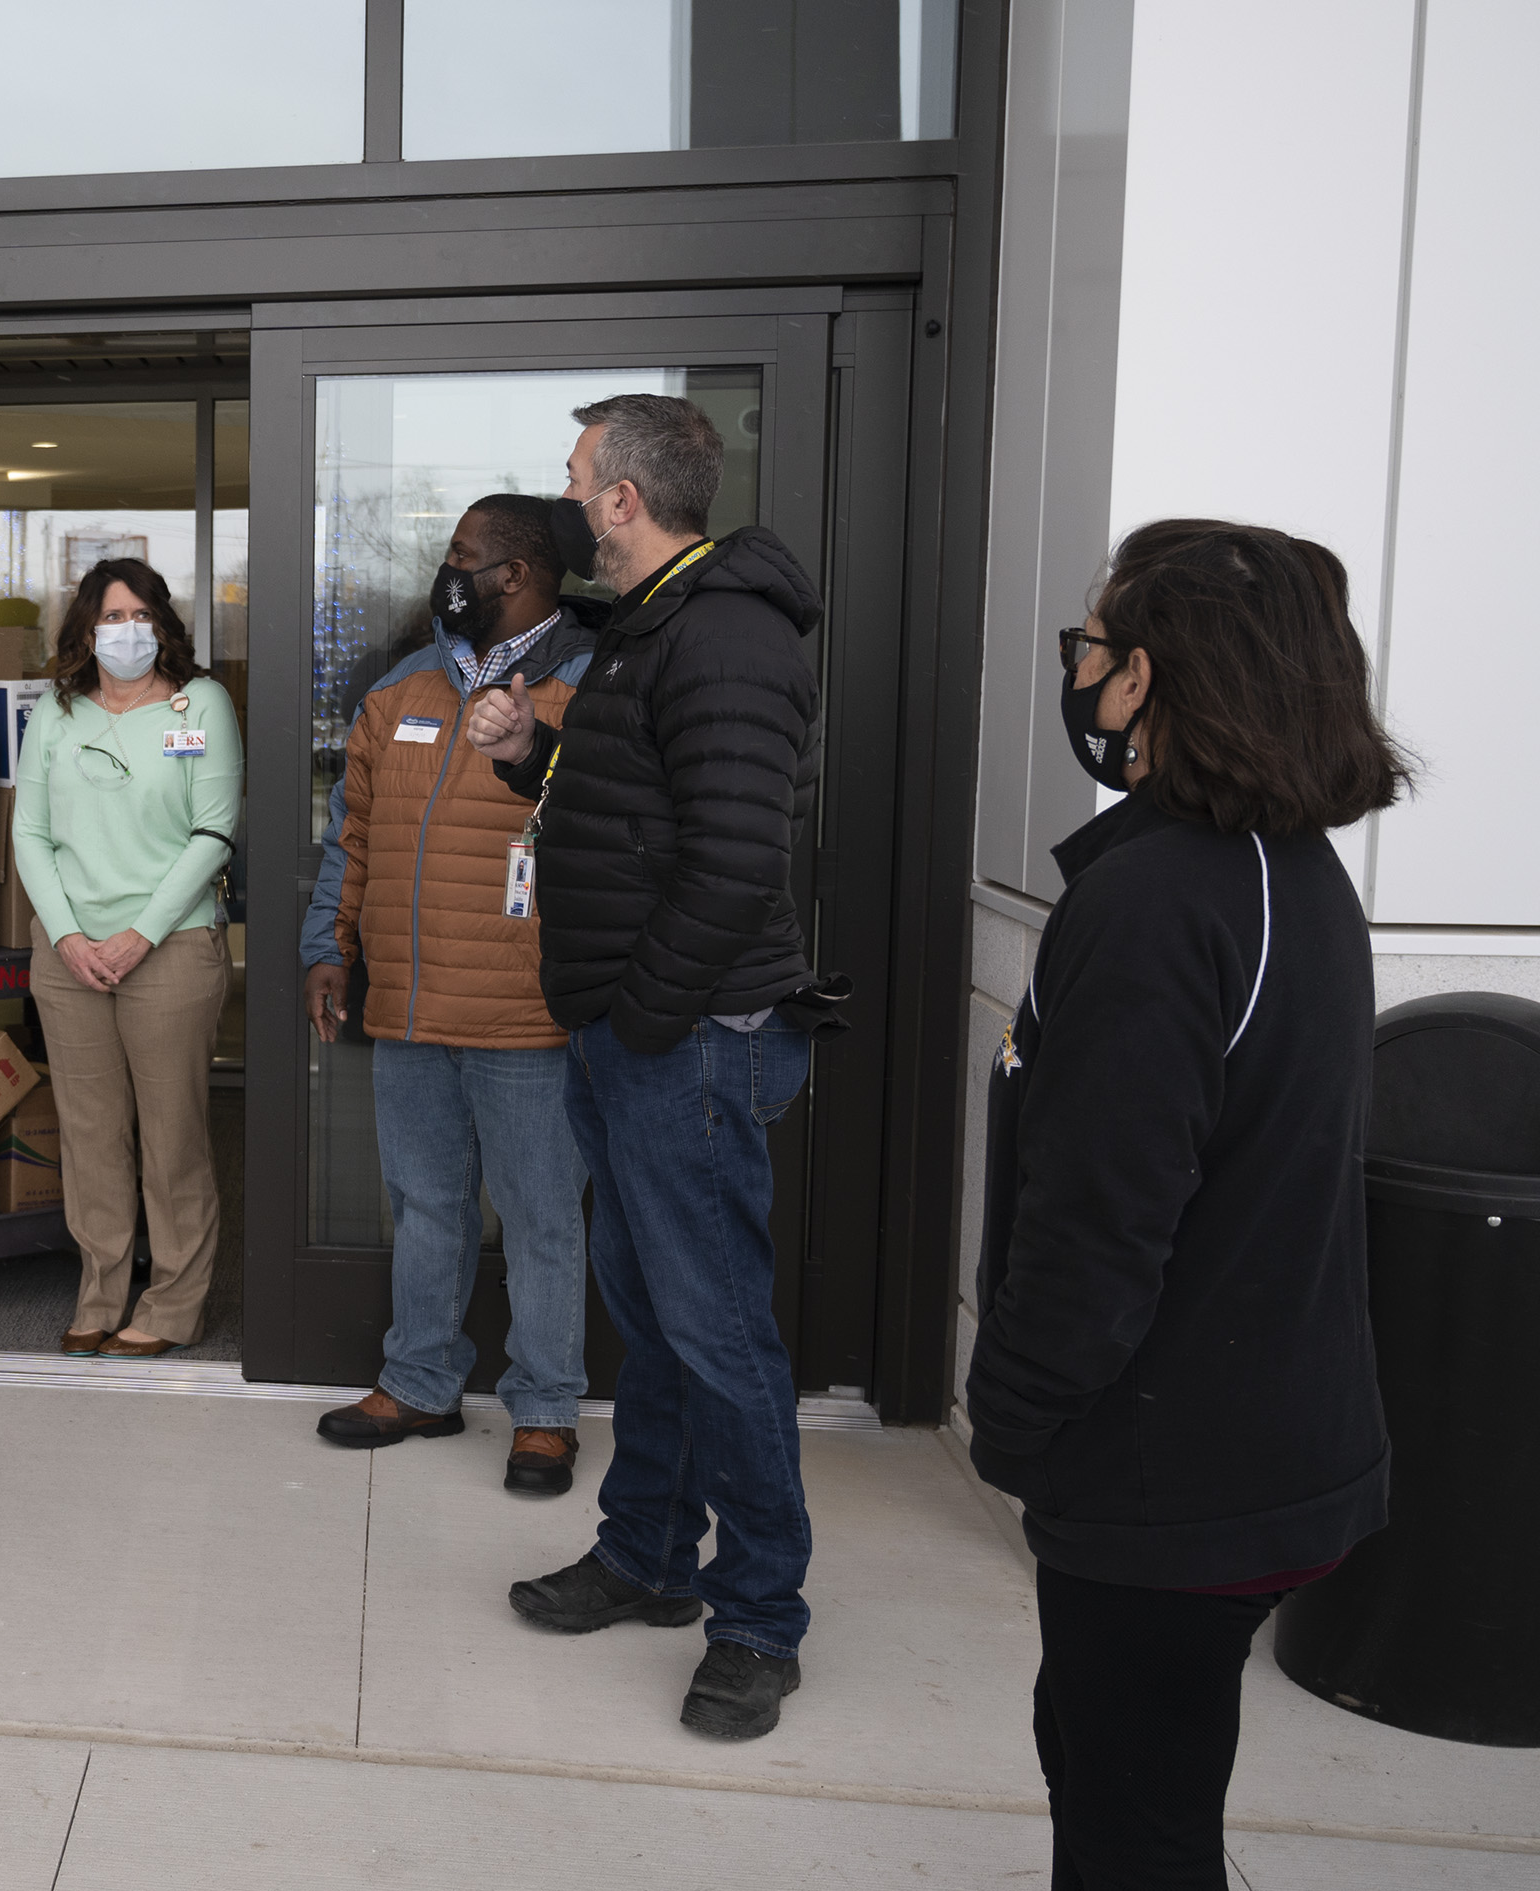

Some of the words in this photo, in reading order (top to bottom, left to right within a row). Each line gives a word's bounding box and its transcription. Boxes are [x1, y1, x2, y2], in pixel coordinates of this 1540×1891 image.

[186, 736, 204, 746] RN
[1095, 737, 1108, 764] adidas
[10, 1074, 21, 1088] UP
